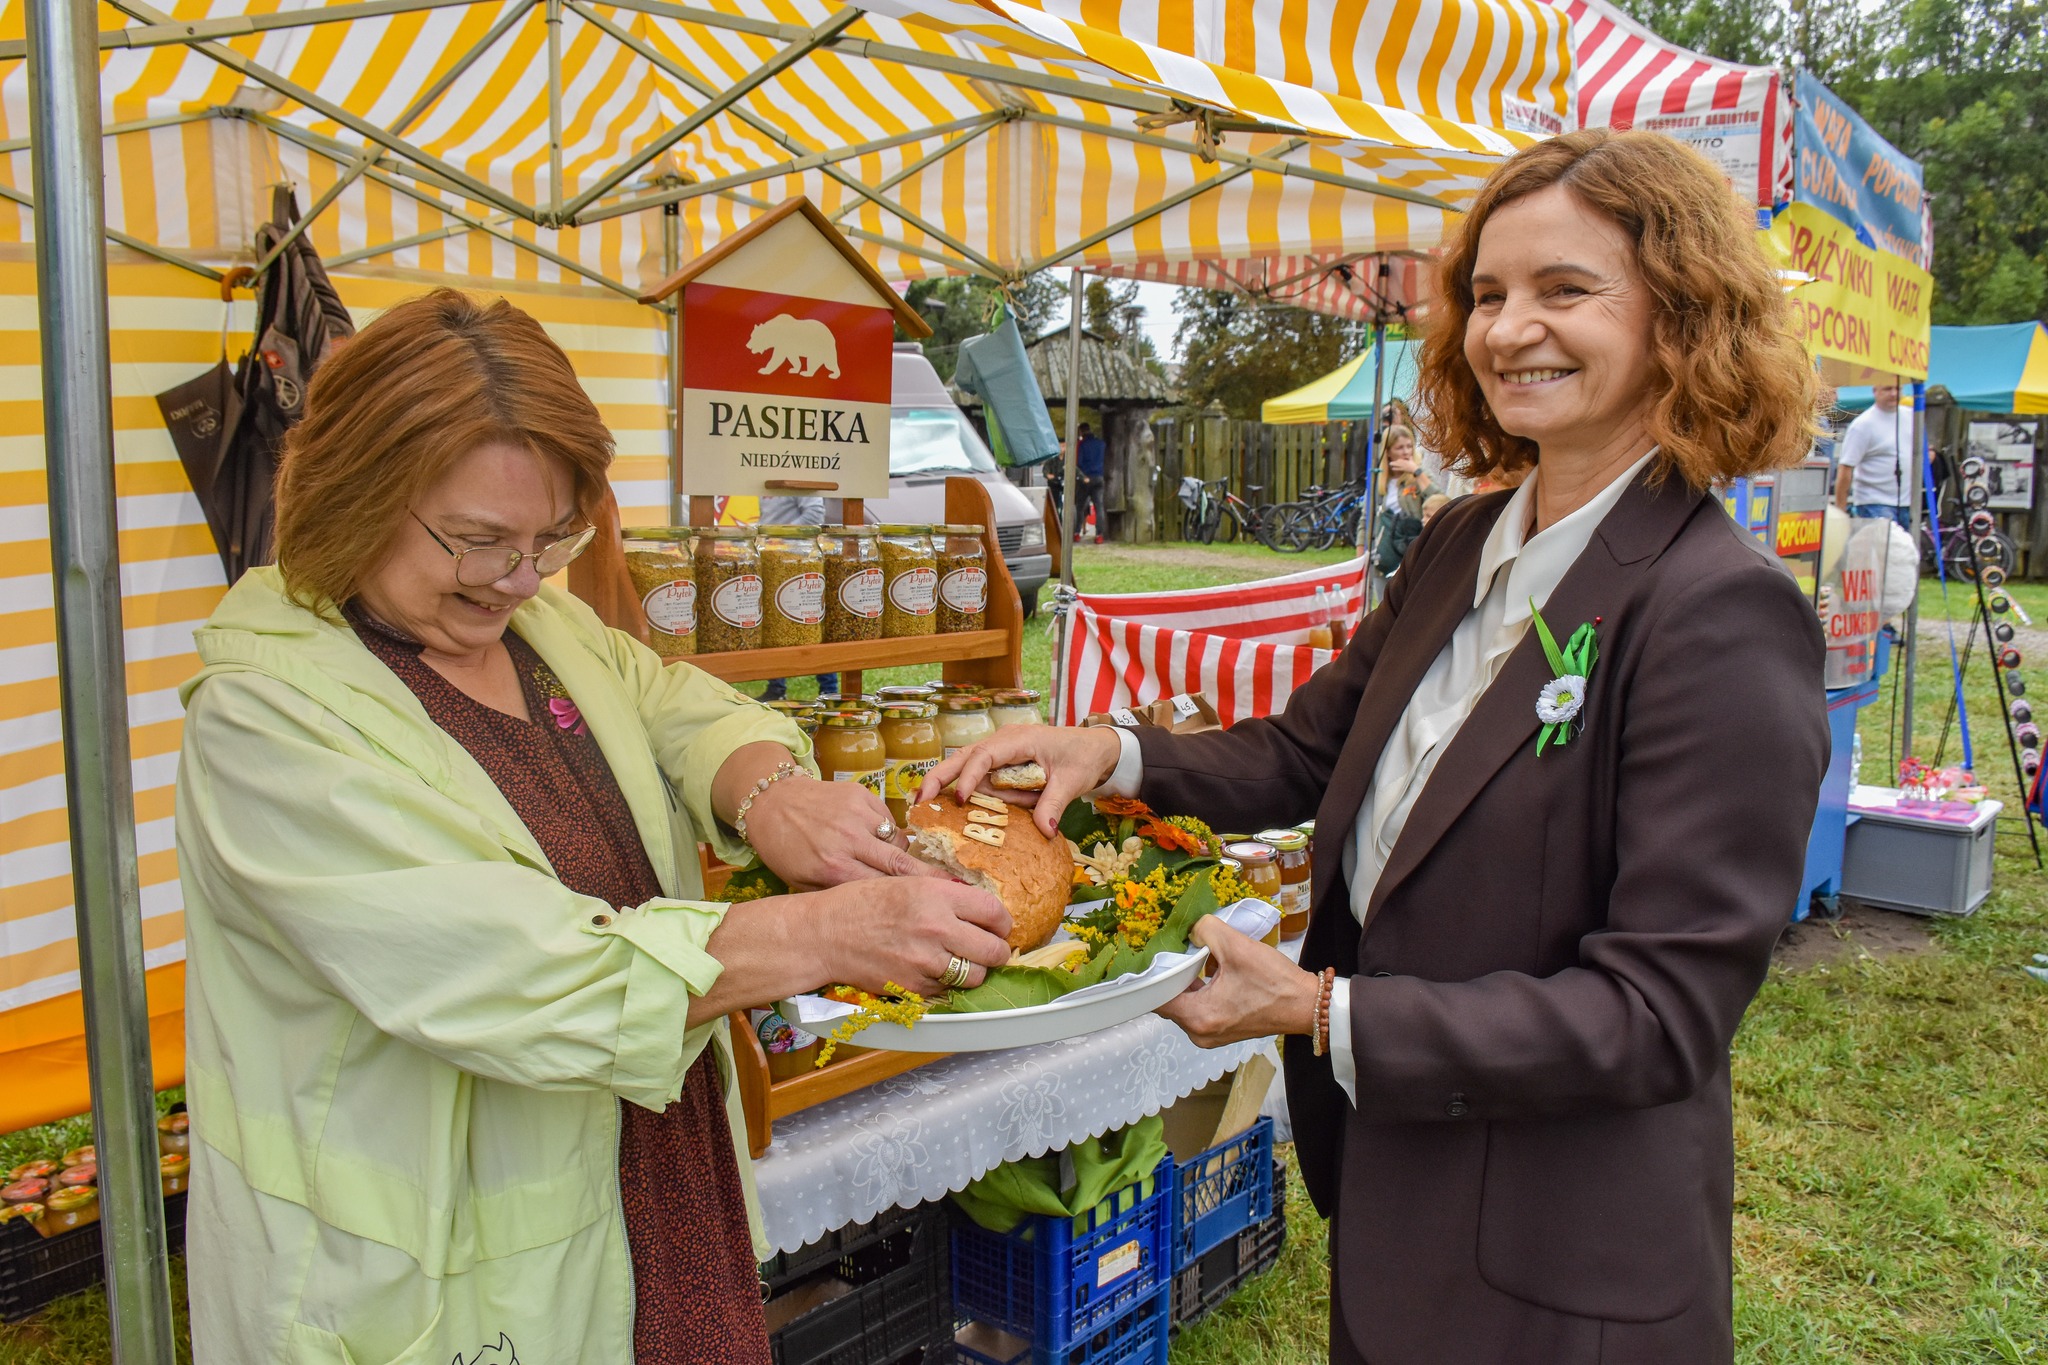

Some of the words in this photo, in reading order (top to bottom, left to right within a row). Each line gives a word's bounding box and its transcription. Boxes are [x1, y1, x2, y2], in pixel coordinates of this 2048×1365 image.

[1814, 96, 1852, 160] WATA
[1887, 271, 1921, 320] WATA
[1792, 298, 1871, 357] OPCORN
[709, 402, 870, 444] PASIEKA
[740, 451, 841, 470] NIEDŹWIEDŹ
[1776, 518, 1822, 548] POPCORN
